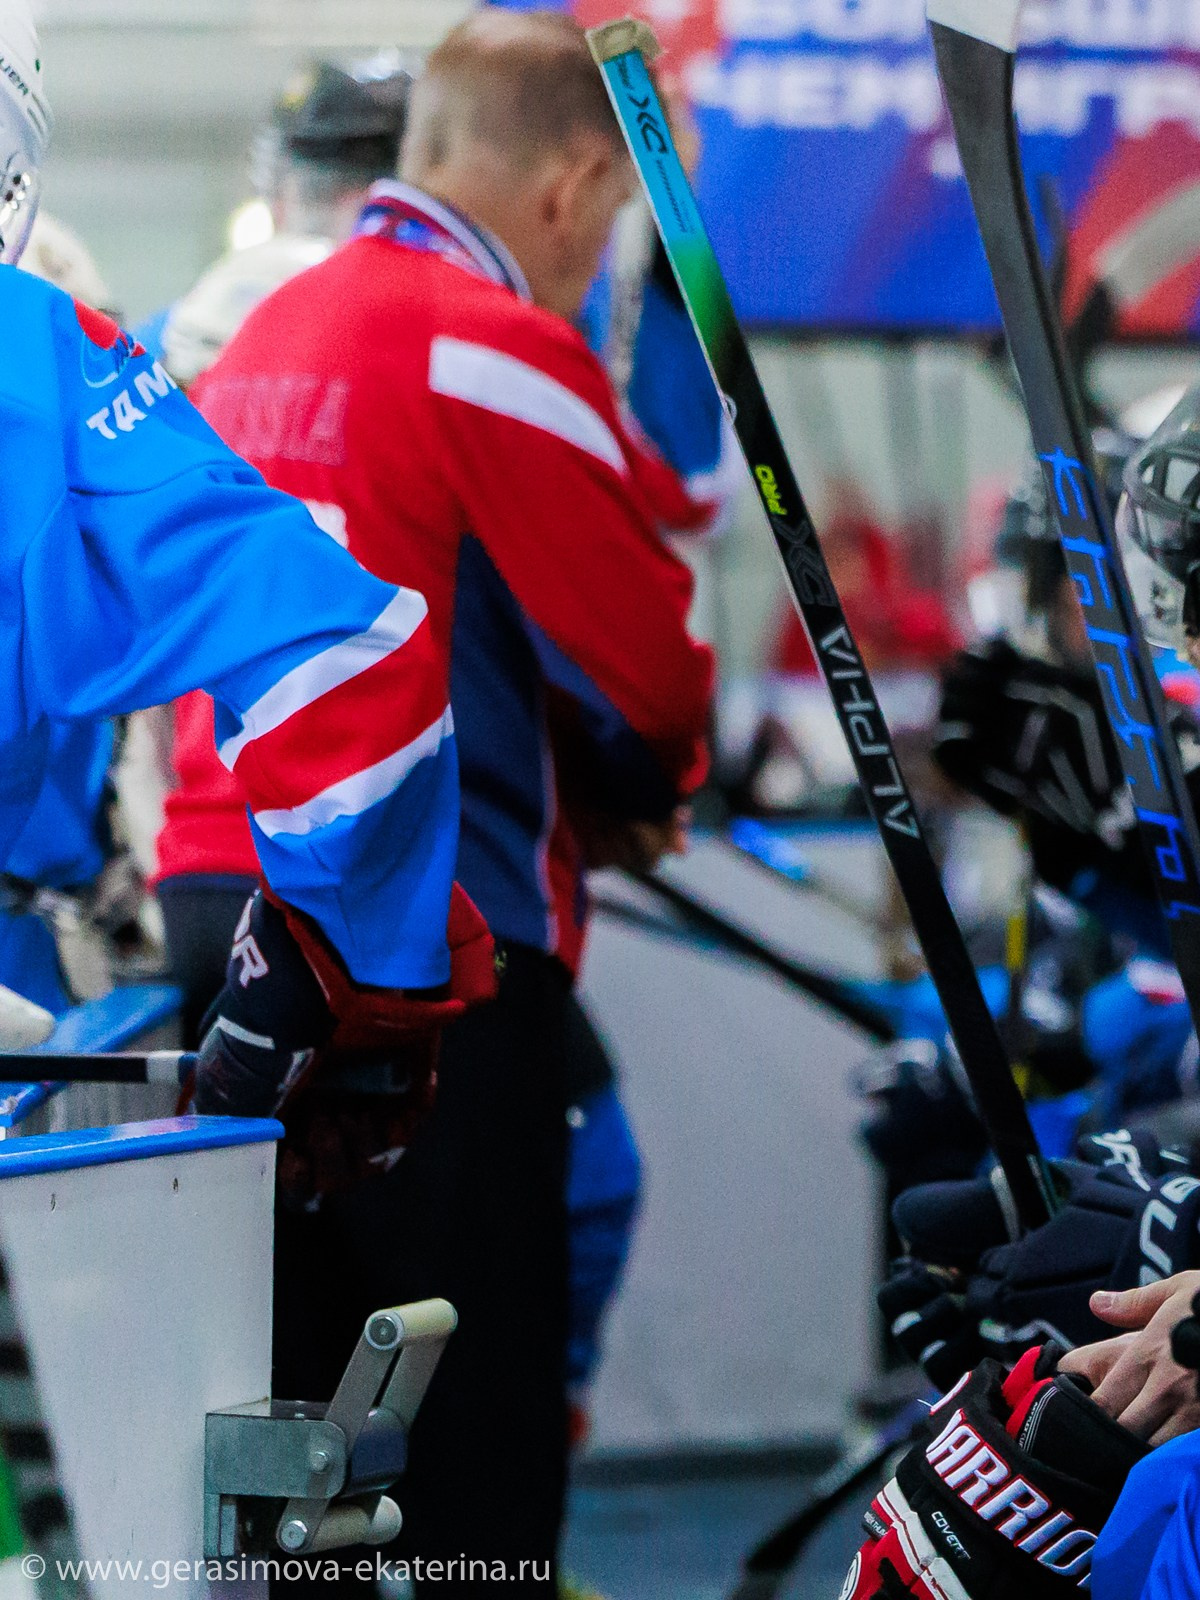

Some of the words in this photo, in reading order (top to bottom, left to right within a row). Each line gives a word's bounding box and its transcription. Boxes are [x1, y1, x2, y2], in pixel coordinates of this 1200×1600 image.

[756, 464, 787, 516] PRO
[819, 623, 921, 839] ALPHA
[930, 1369, 1098, 1588] ARRIO
